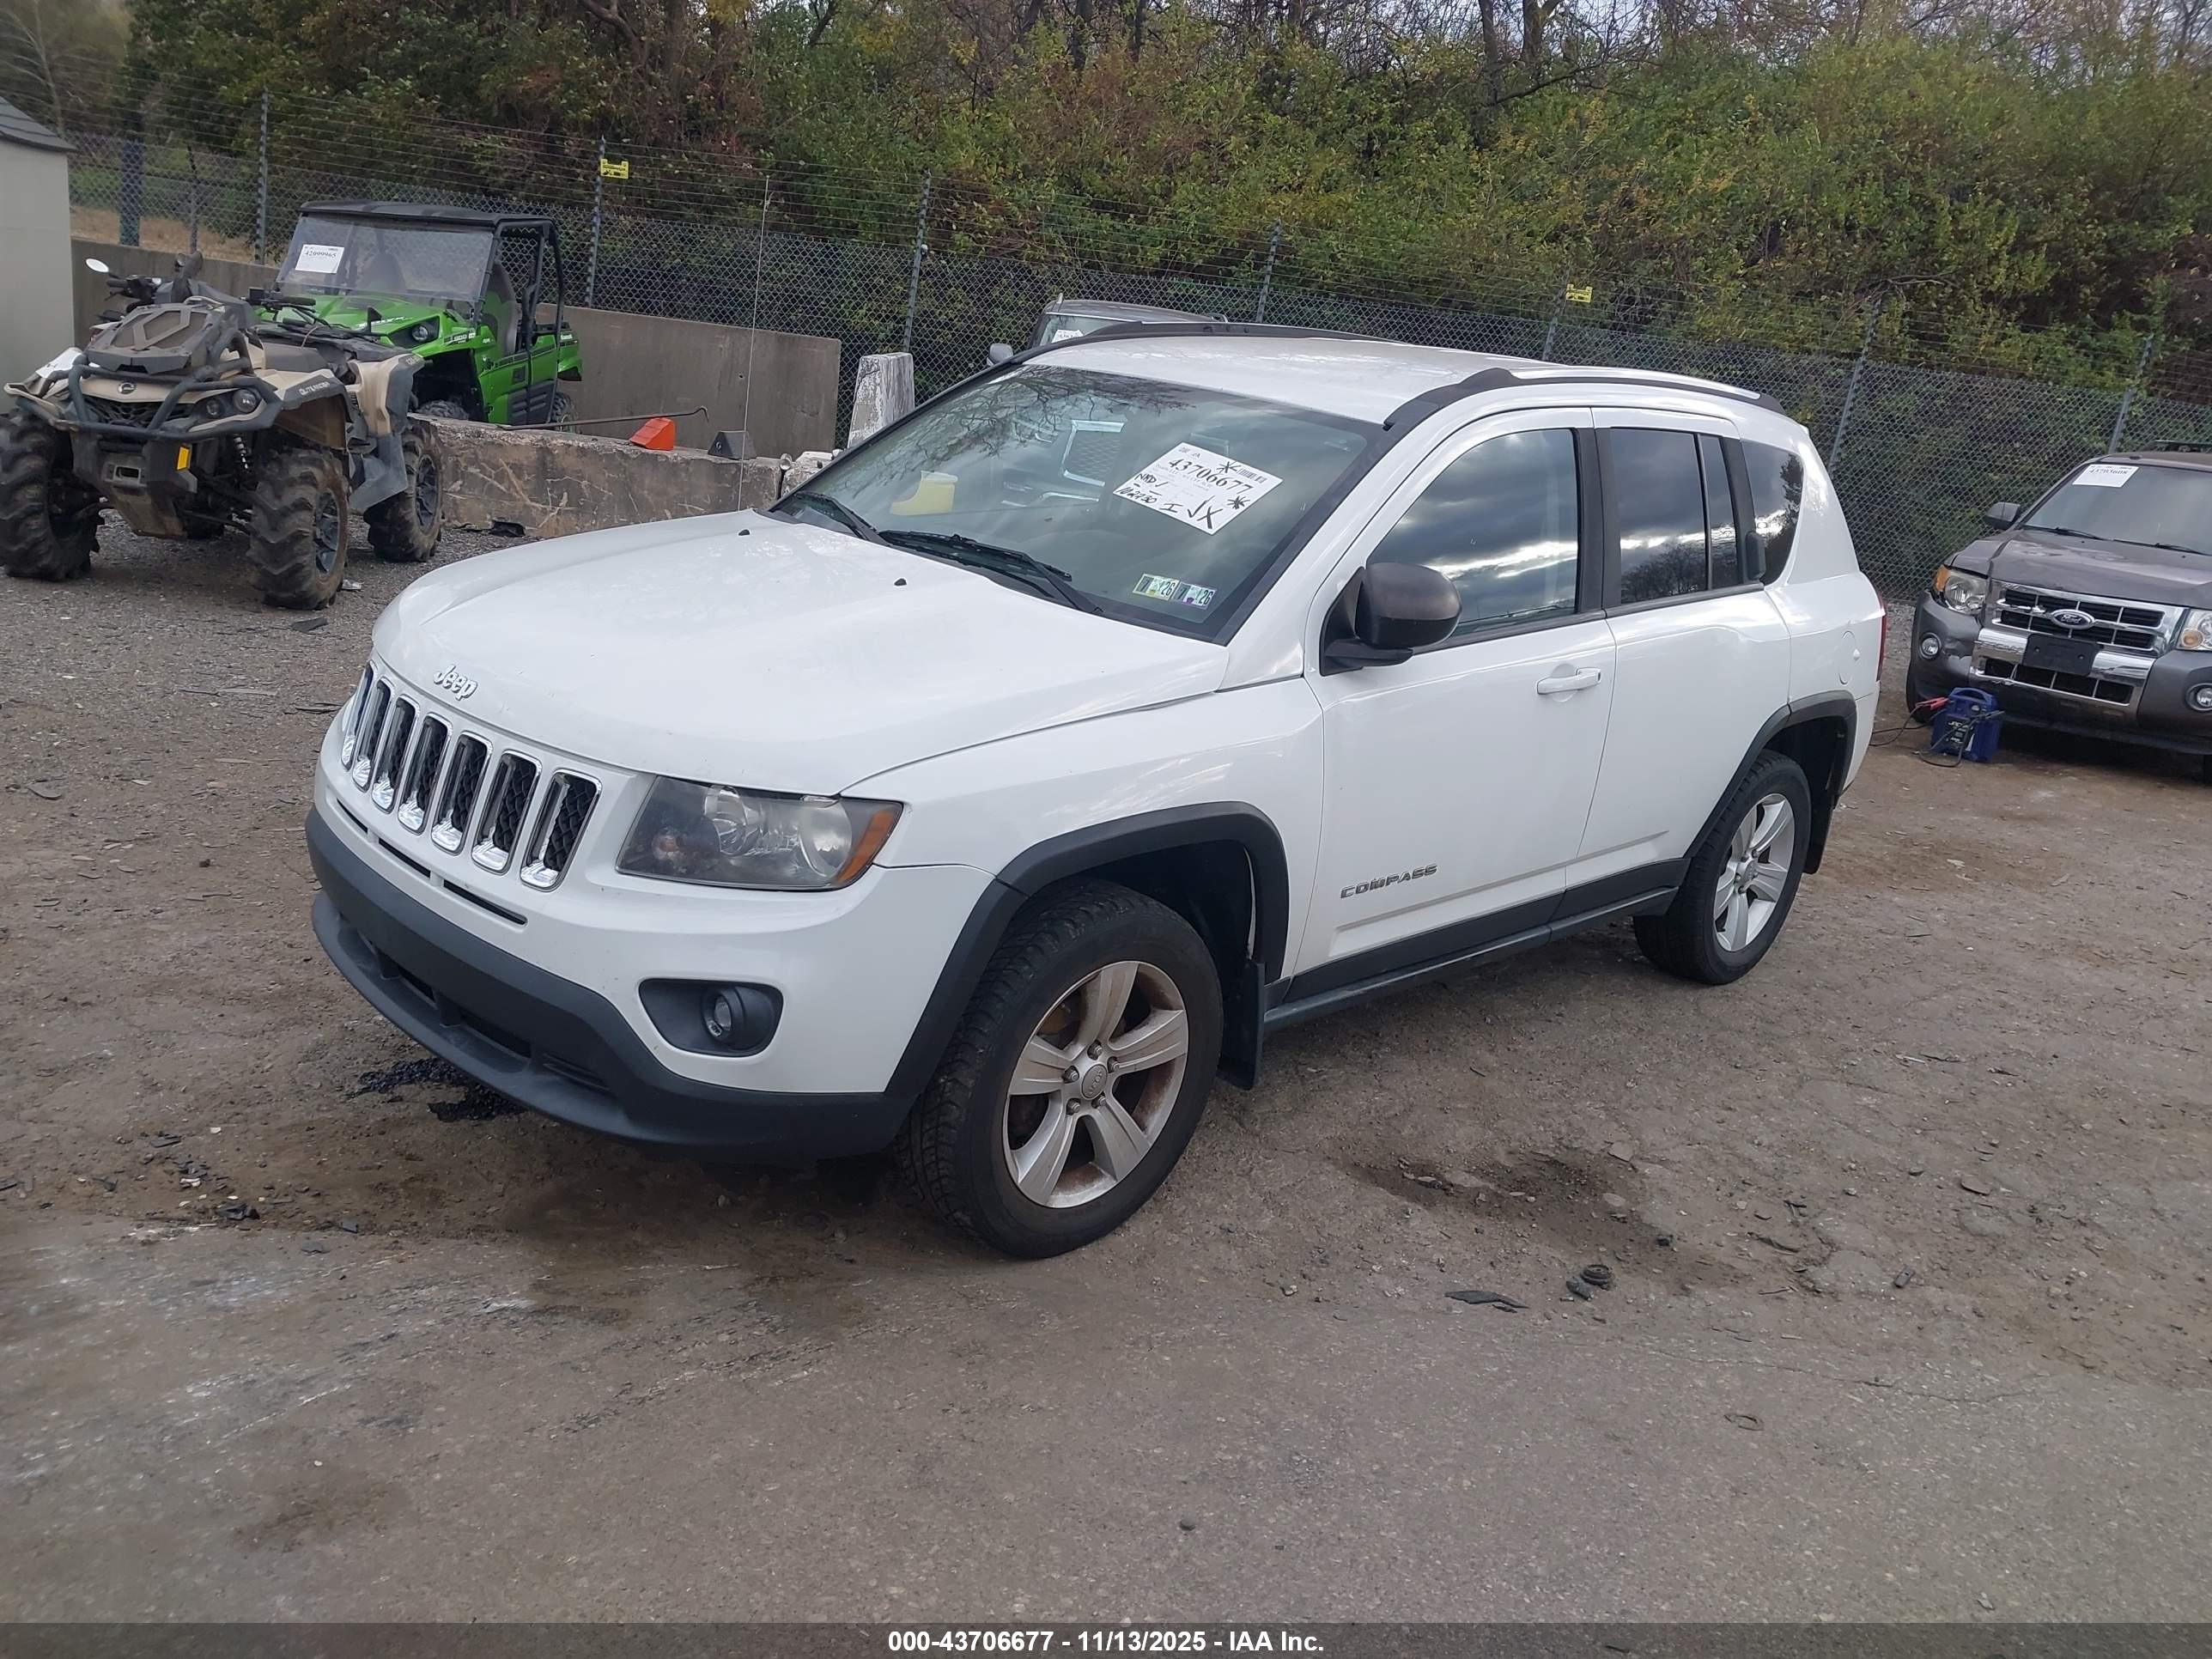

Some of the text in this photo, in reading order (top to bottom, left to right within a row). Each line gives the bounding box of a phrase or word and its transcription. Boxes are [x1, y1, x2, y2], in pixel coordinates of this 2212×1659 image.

[1169, 459, 1254, 494] 43706677
[1160, 581, 1176, 596] 26
[1199, 589, 1214, 605] 26
[2061, 613, 2082, 624] Ford
[433, 664, 478, 702] Jeep
[1340, 863, 1438, 899] COMPASS
